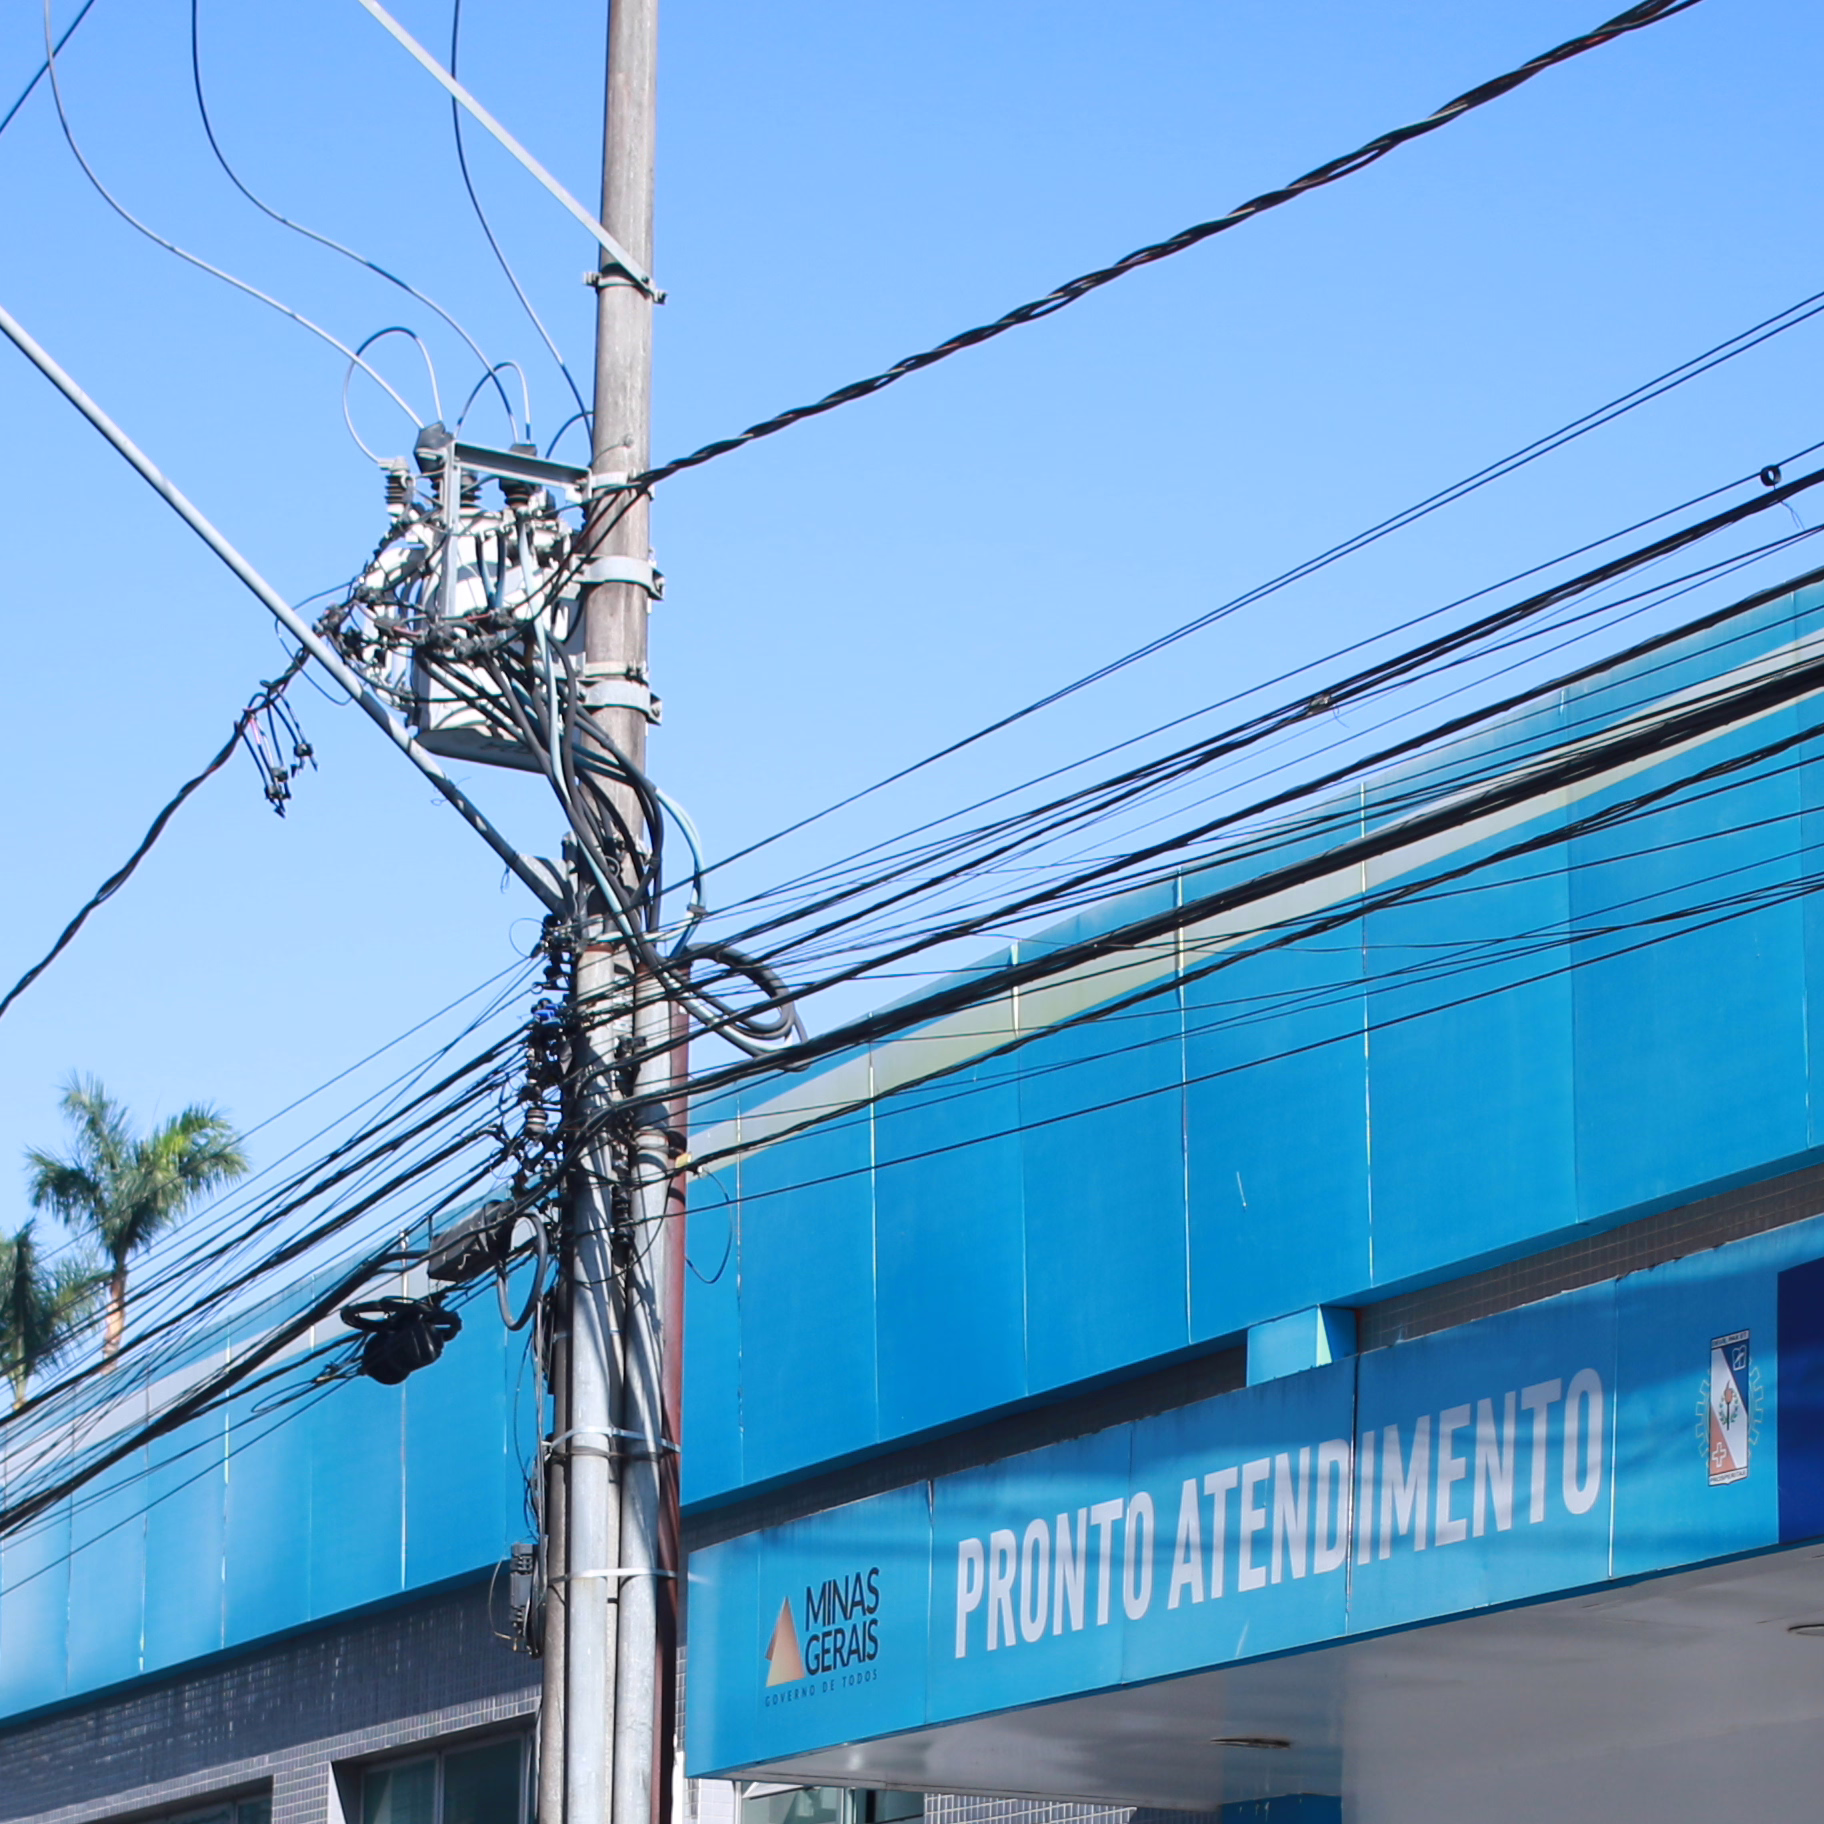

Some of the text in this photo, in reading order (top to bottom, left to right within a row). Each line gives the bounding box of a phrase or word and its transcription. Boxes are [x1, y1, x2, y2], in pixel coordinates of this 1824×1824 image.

[954, 1367, 1604, 1660] PRONTO ATENDIMENTO
[805, 1566, 880, 1632] MINAS
[805, 1617, 879, 1676] GERAIS
[765, 1668, 878, 1708] GOVERNO DE TODOS
